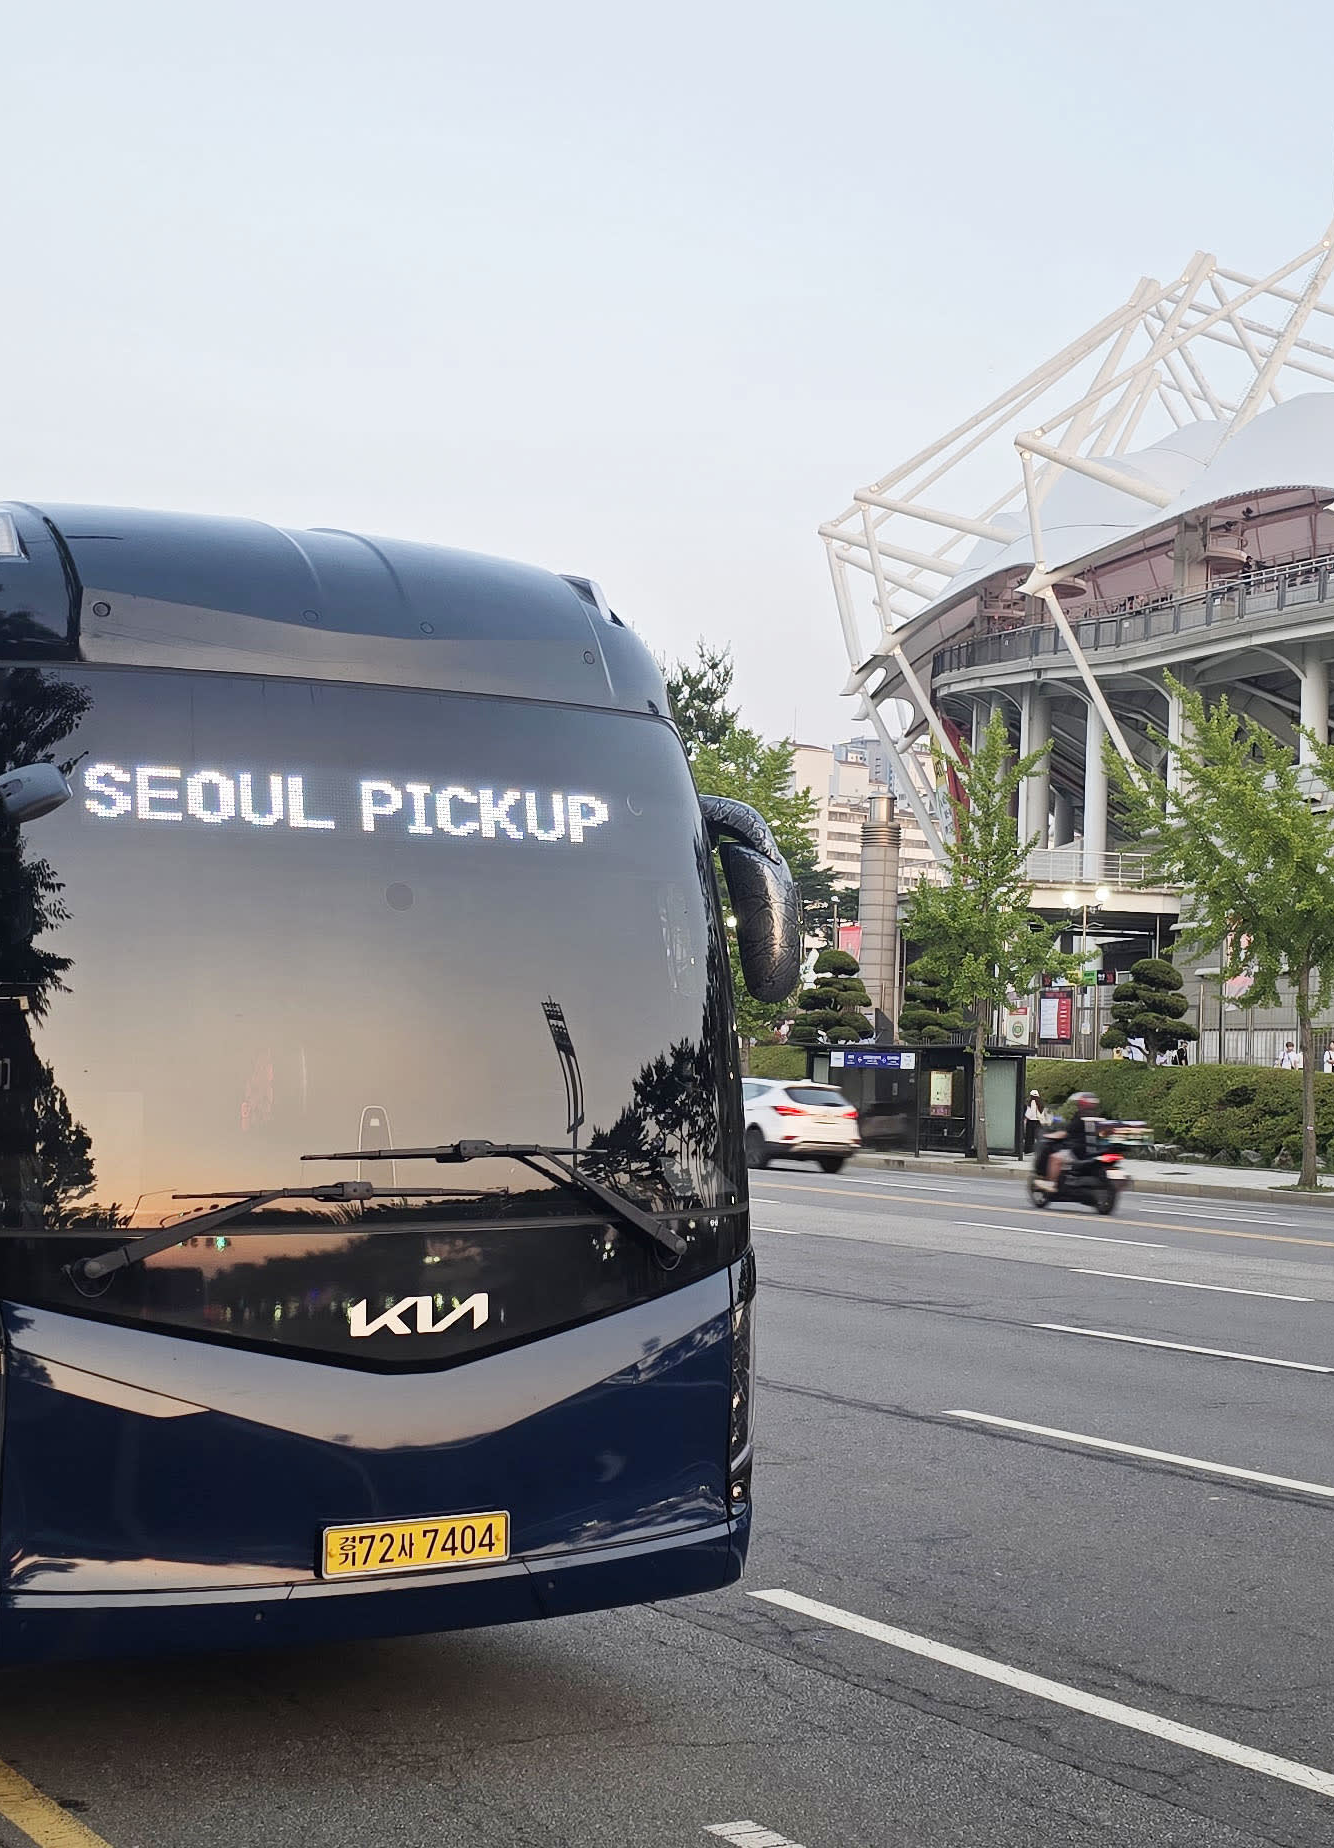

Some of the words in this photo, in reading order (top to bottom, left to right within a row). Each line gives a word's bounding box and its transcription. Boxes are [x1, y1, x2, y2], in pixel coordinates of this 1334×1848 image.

[84, 763, 336, 830] SEOUL
[360, 780, 610, 844] PICKUP
[348, 1292, 489, 1337] KIA
[422, 1522, 496, 1559] 7404
